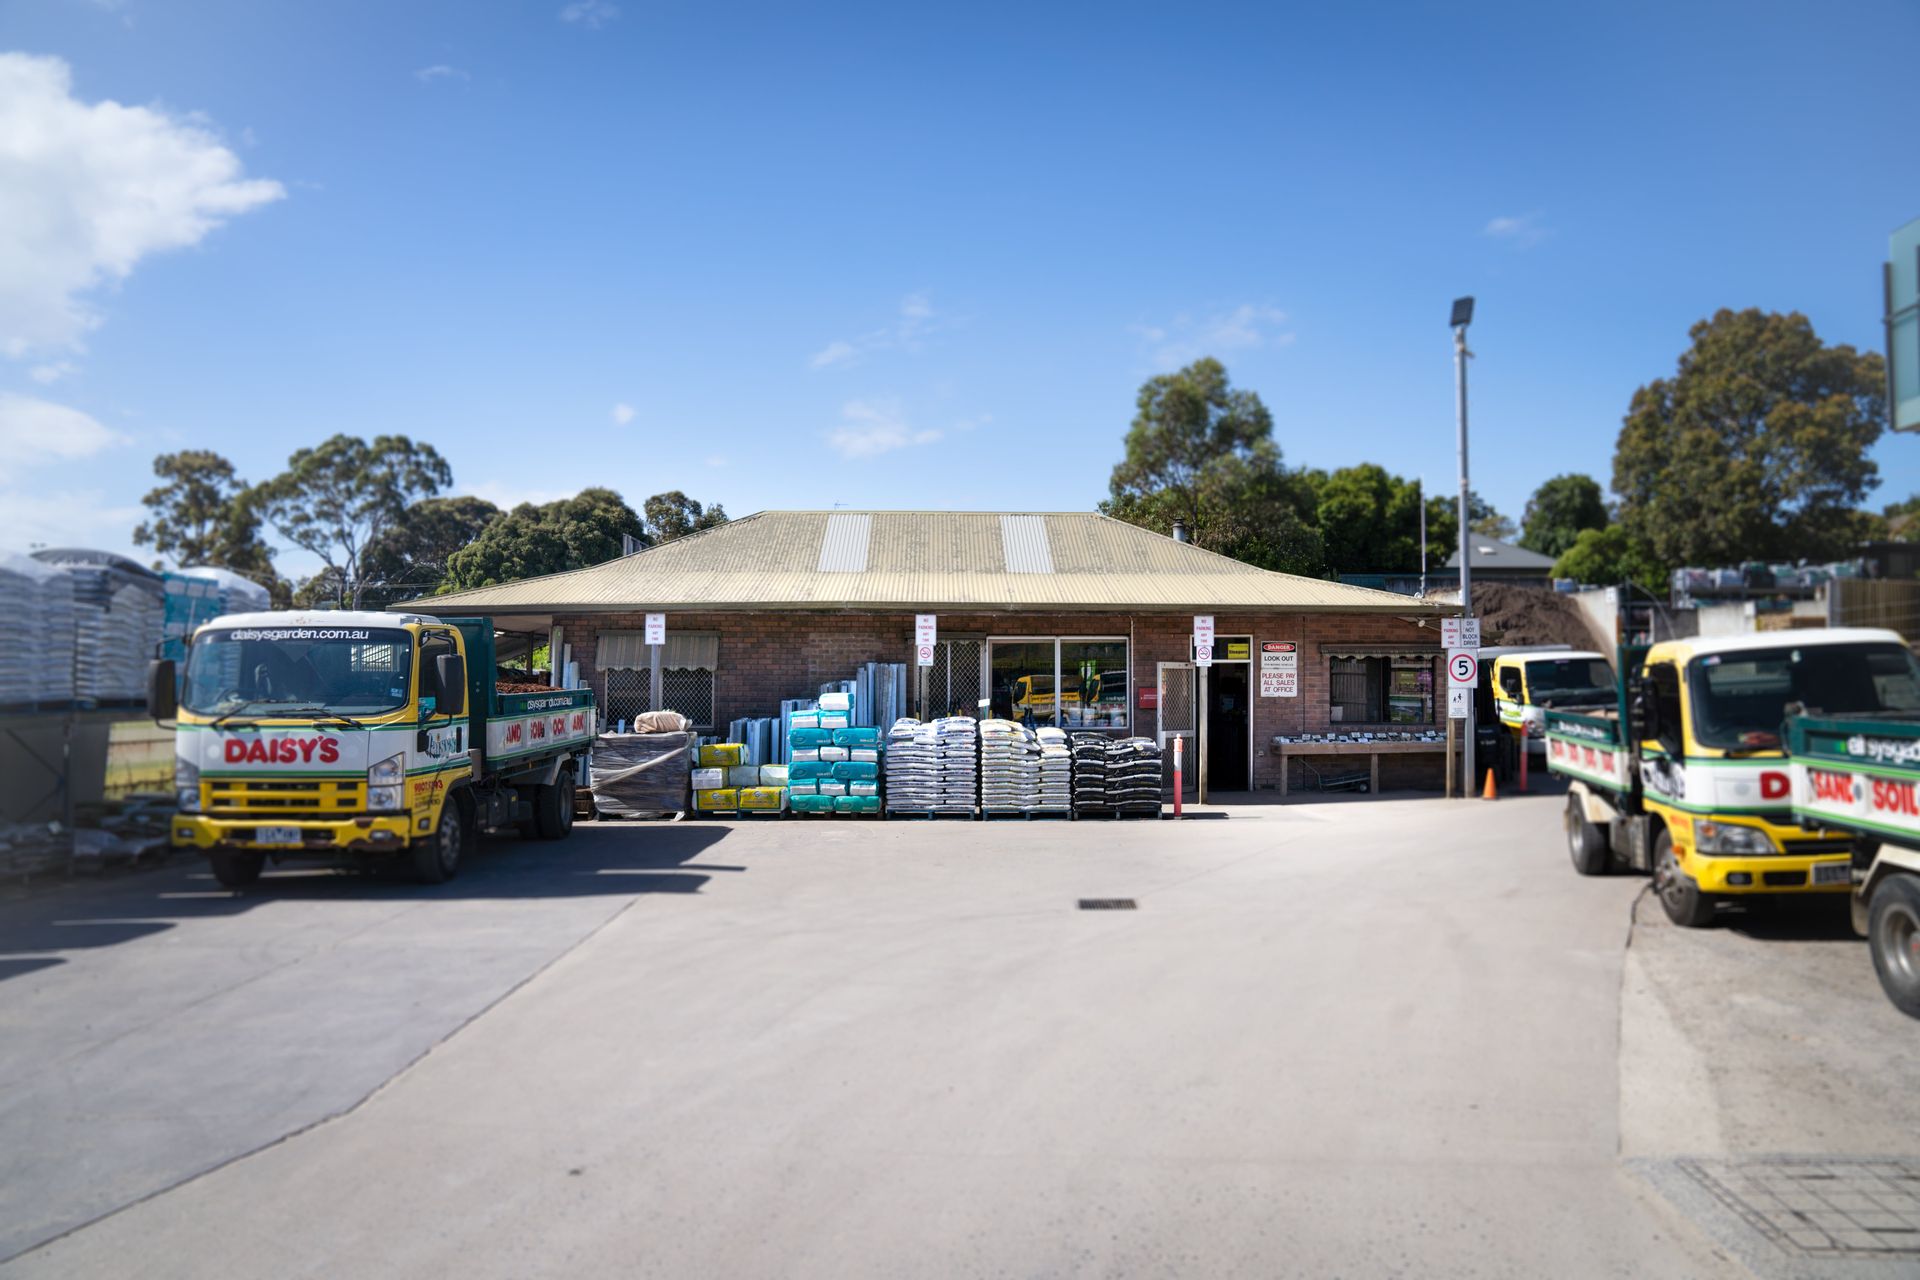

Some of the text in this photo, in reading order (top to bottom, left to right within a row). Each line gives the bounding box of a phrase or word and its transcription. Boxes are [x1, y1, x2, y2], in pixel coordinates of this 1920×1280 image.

[230, 629, 369, 641] daisysgarden.com.au
[1262, 672, 1296, 680] PLEASE PAY
[1458, 660, 1469, 676] 5
[224, 735, 340, 764] DAISY'S
[1872, 778, 1920, 816] SOIL
